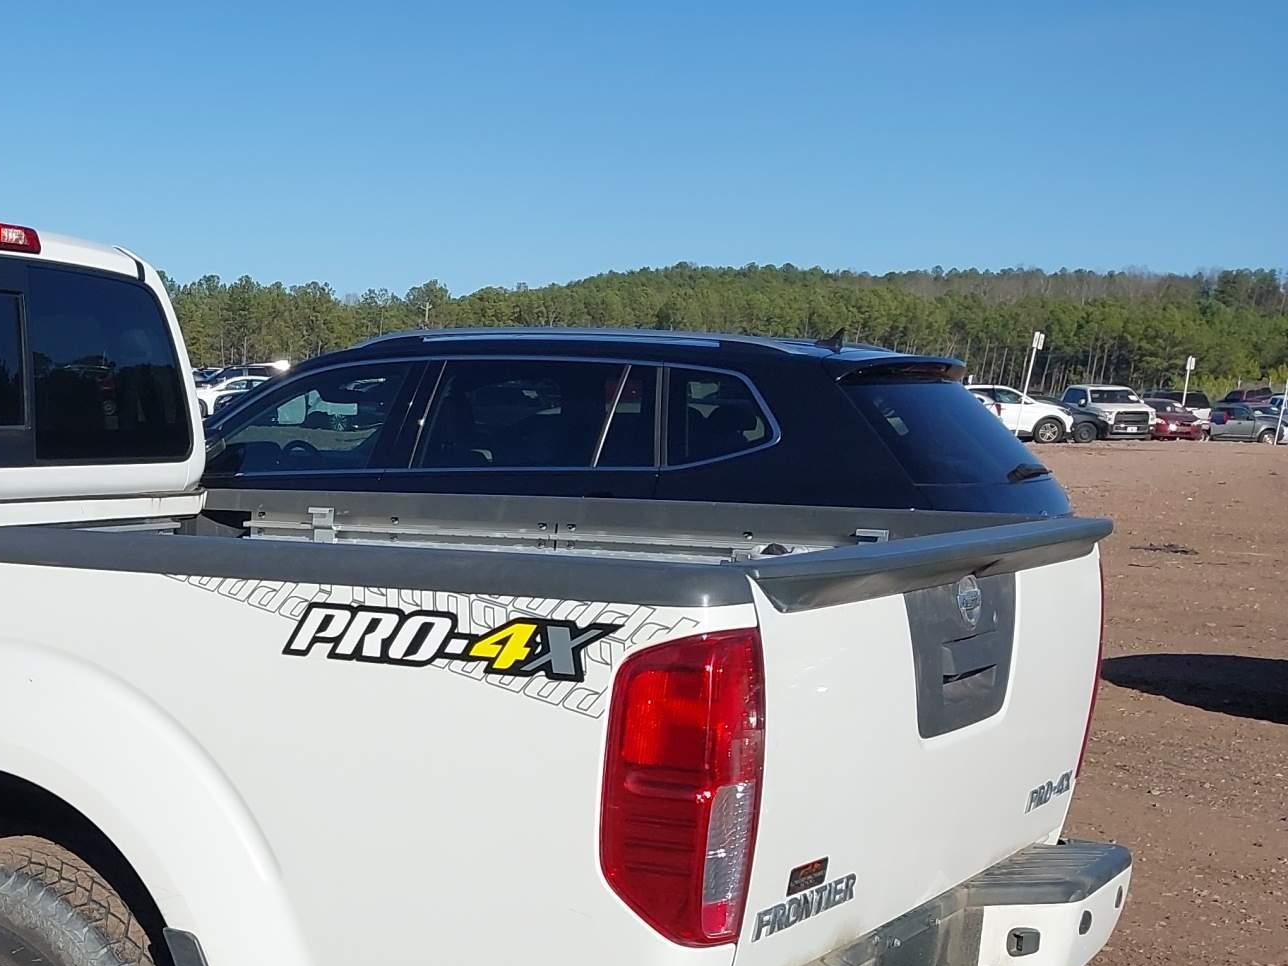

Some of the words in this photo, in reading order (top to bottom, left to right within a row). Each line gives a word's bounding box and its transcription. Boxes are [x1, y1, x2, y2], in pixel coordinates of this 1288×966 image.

[283, 602, 624, 683] PRO-4X
[1024, 769, 1073, 814] PRO-4X
[750, 873, 857, 943] FRONTIER
